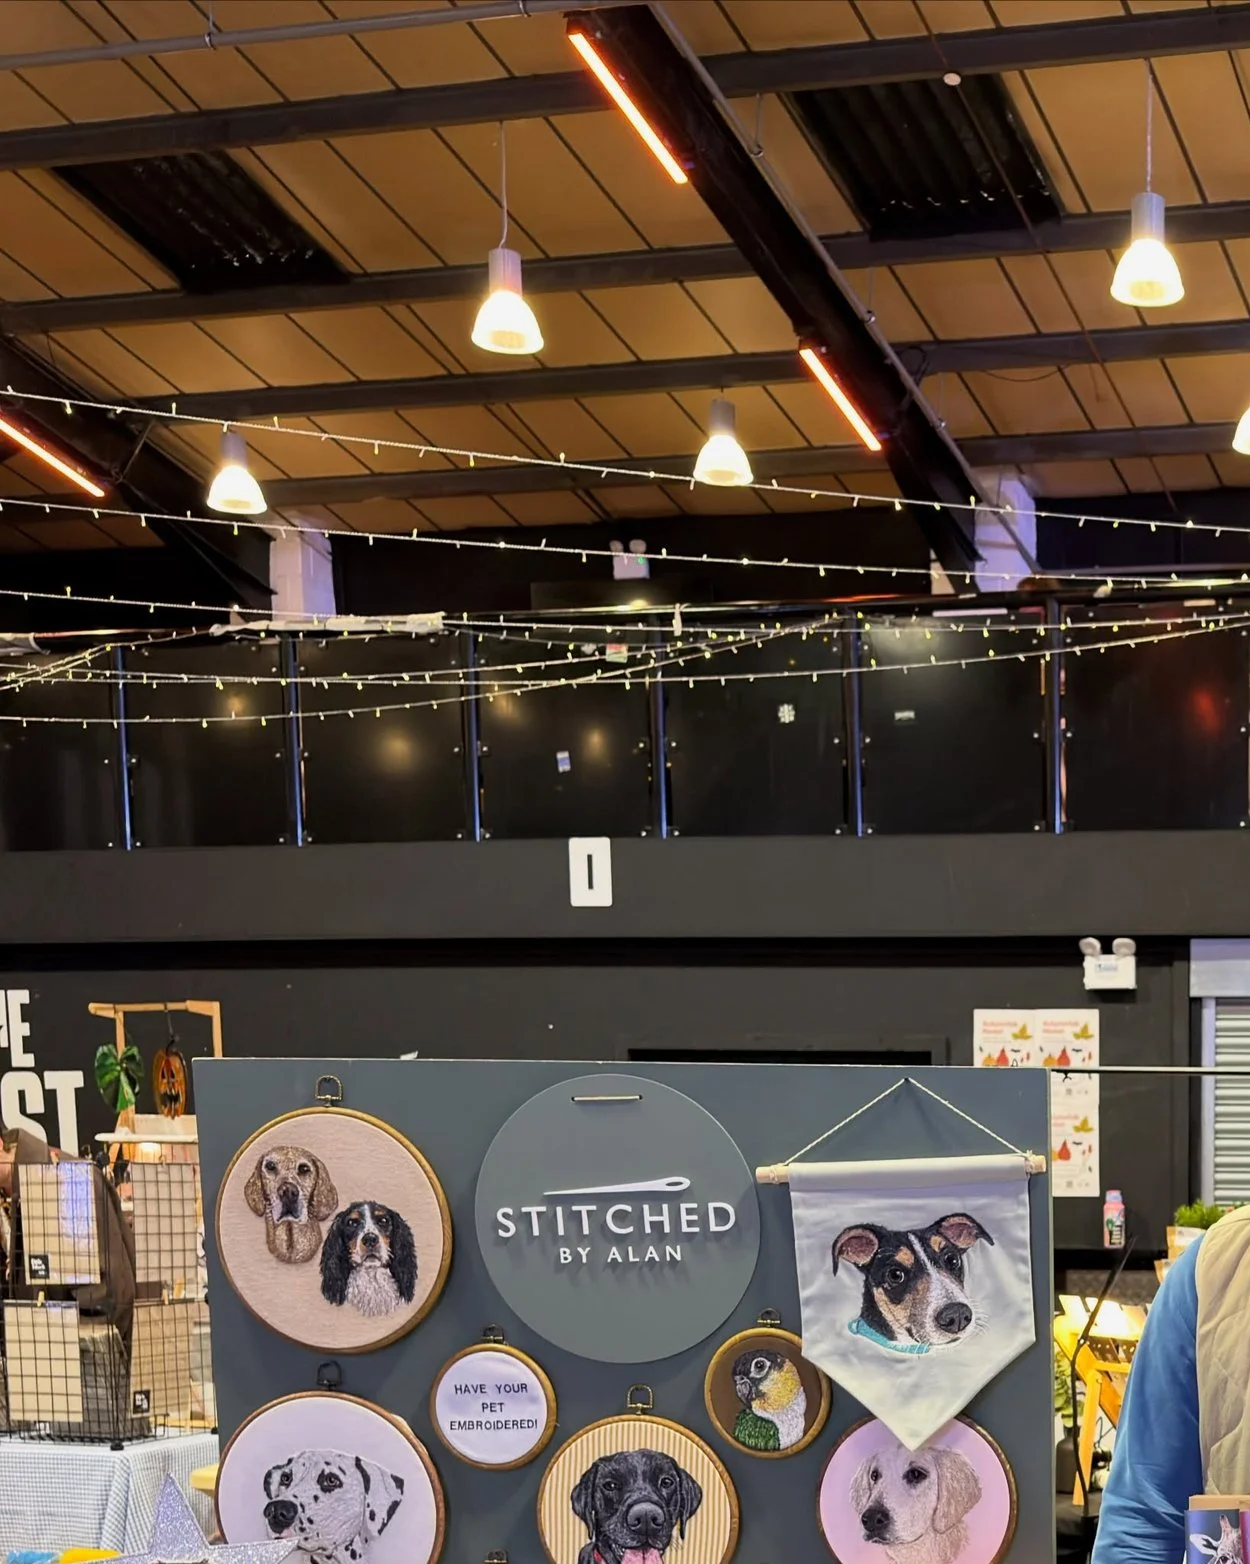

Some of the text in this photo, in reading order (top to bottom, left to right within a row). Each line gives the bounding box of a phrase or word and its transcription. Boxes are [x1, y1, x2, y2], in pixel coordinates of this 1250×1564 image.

[496, 1202, 736, 1238] STITCHED
[559, 1245, 682, 1264] BY ALAN
[454, 1383, 528, 1395] HAVE YOUR
[481, 1402, 505, 1413] PET
[450, 1419, 538, 1431] EMBROIDERED!
